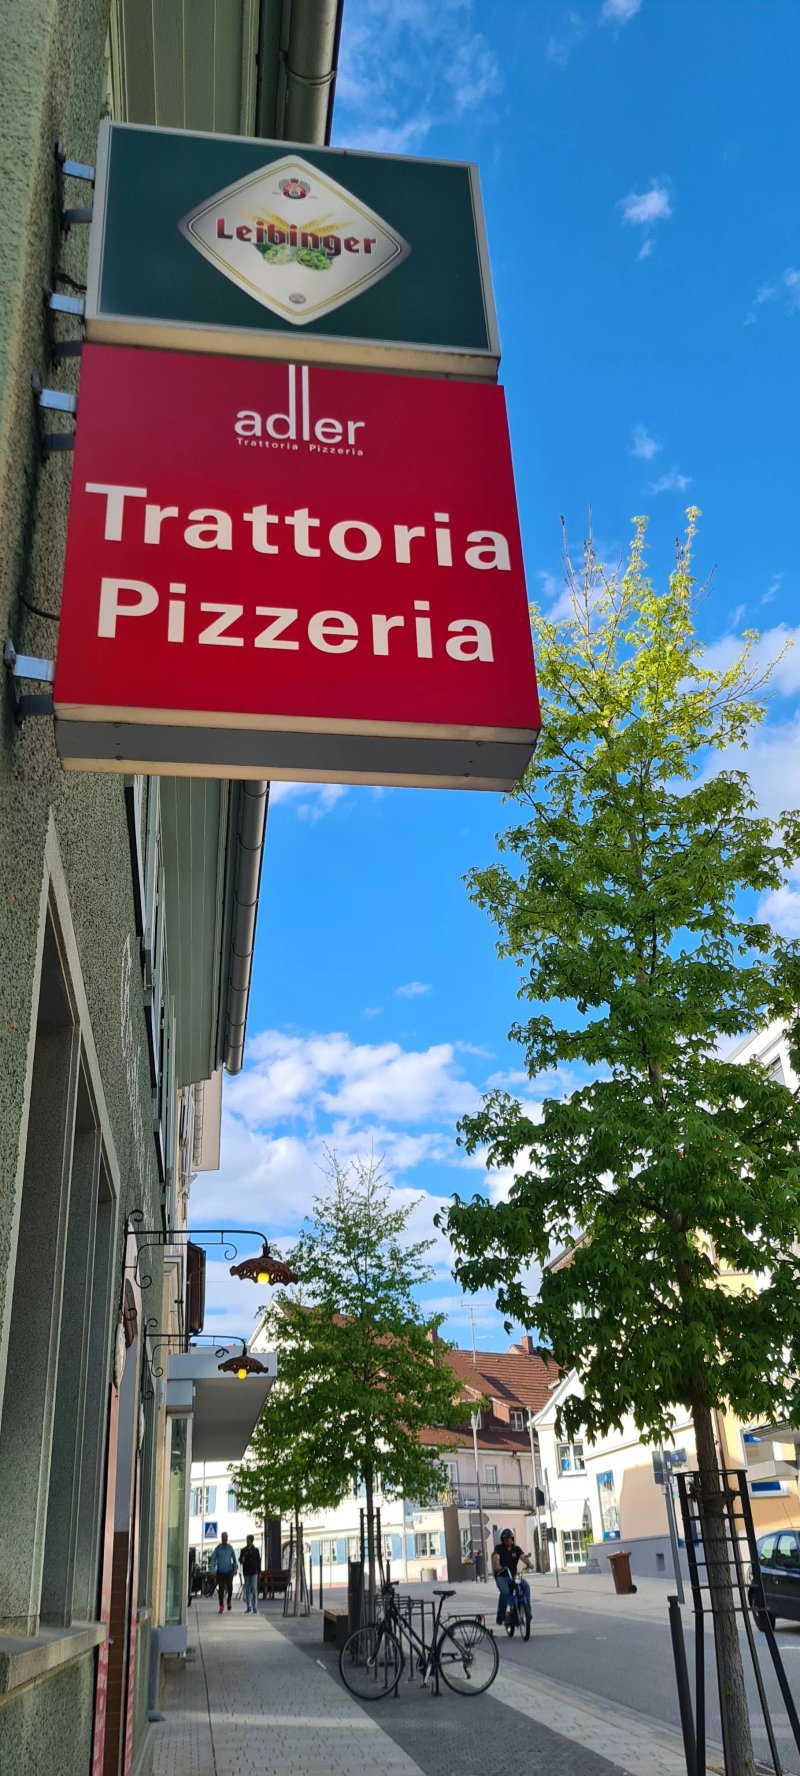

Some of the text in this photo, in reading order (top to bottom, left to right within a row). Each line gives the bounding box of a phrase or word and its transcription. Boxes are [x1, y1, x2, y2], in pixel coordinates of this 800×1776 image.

[216, 217, 377, 258] Leibinger
[234, 363, 365, 446] adler
[236, 437, 364, 457] Trattoria Pizzeria
[84, 482, 512, 571] Trattoria
[97, 577, 495, 663] Pizzeria
